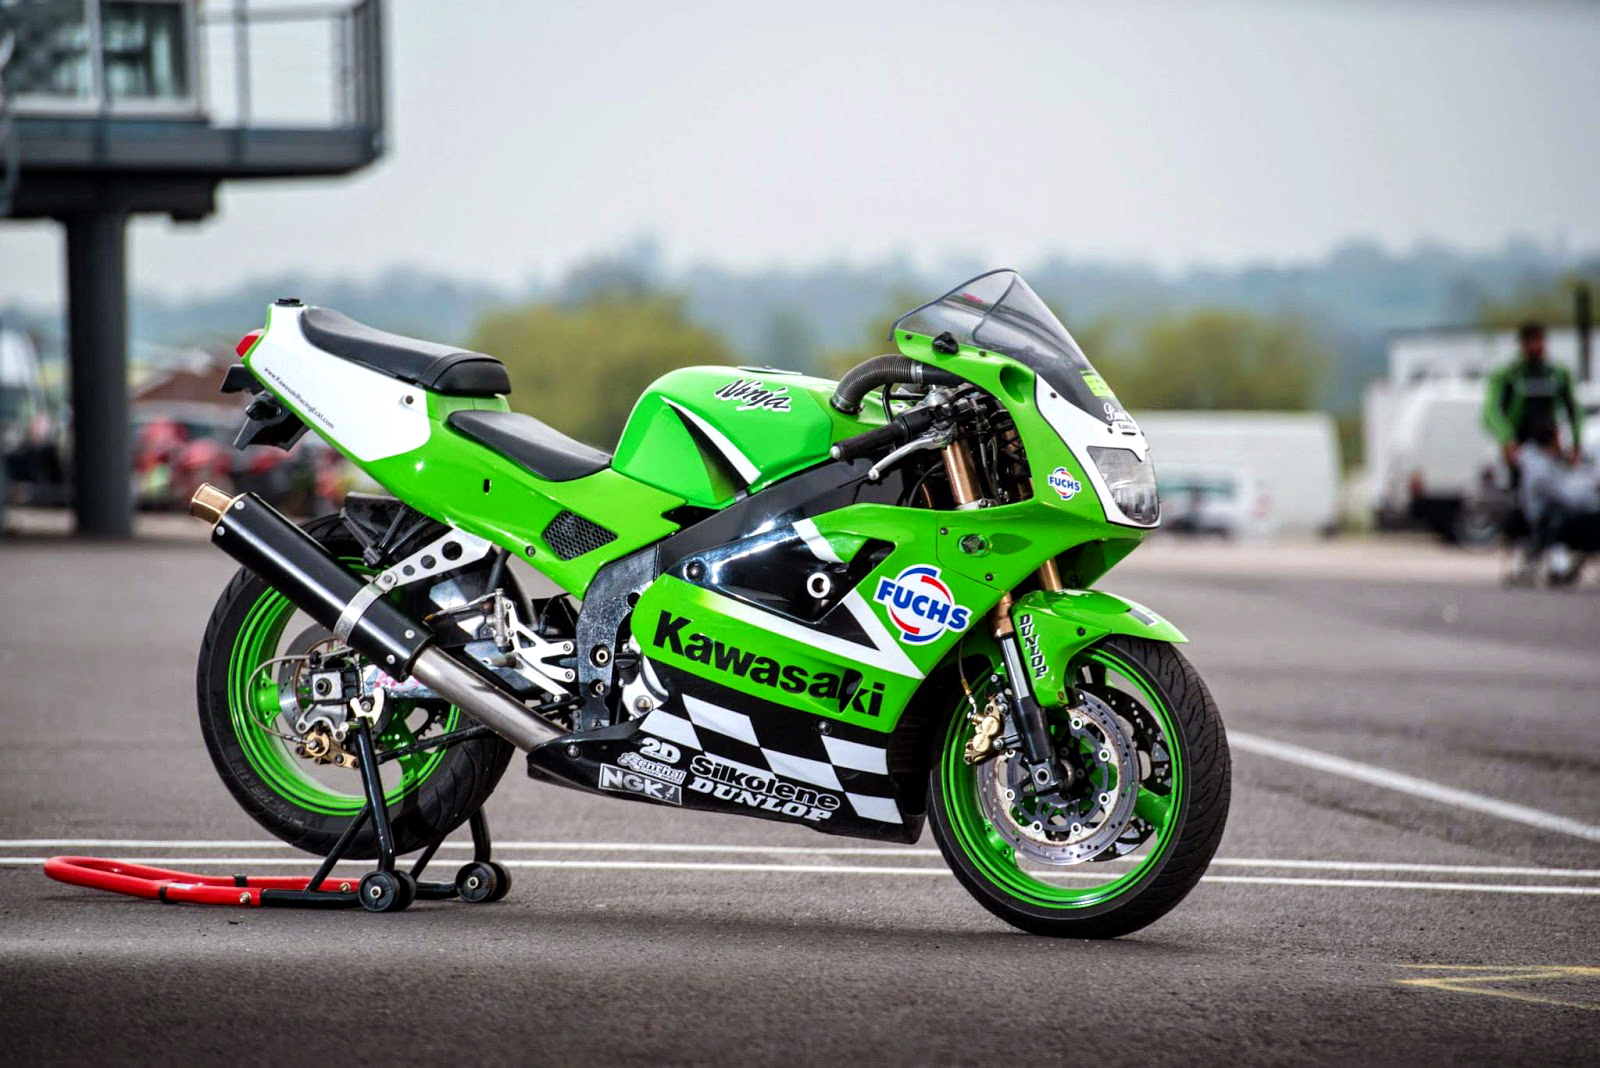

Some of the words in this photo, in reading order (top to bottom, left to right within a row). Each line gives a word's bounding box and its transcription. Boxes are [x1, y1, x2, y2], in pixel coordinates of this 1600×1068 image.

[715, 379, 792, 412] Ninja
[1049, 475, 1081, 492] FUCHS
[876, 580, 969, 631] FUCHS
[652, 609, 886, 718] Kawasaki
[1018, 614, 1049, 680] DUNLOP
[639, 737, 681, 764] 2D
[602, 766, 664, 799] NGK
[687, 777, 832, 822] DUNLOP
[689, 755, 841, 810] Silkolene
